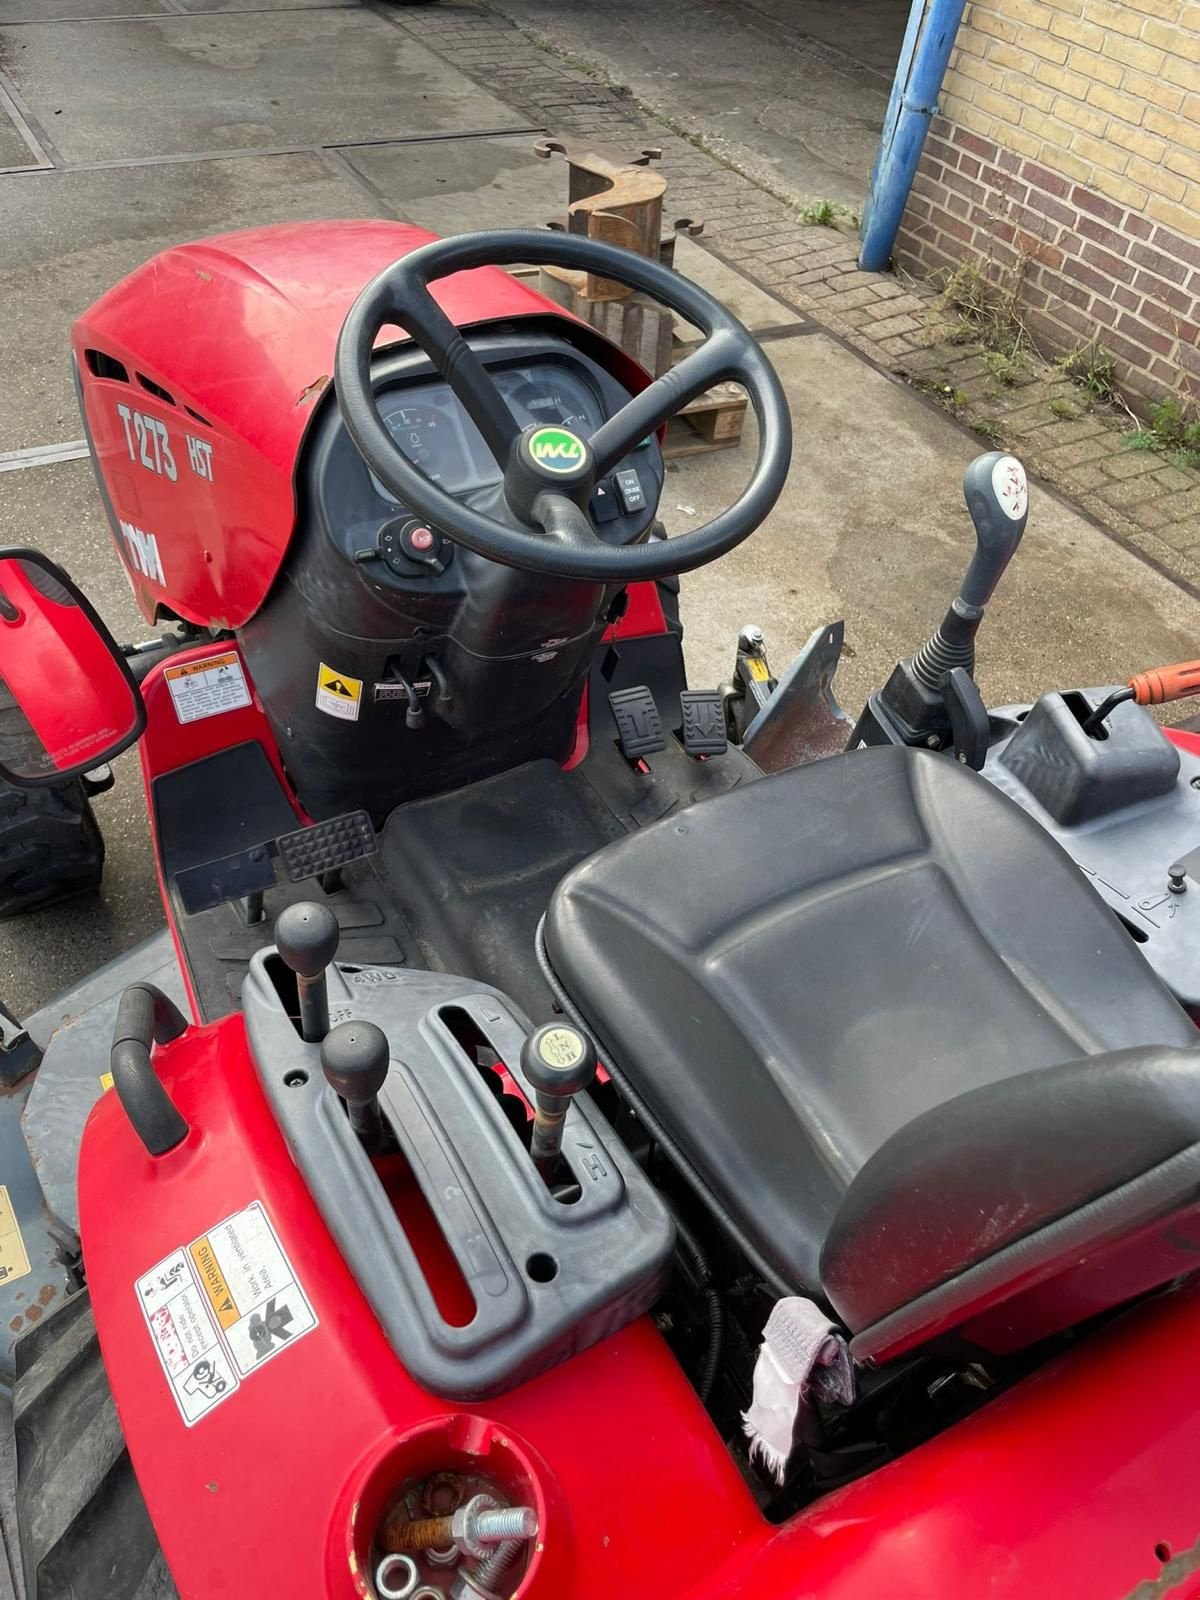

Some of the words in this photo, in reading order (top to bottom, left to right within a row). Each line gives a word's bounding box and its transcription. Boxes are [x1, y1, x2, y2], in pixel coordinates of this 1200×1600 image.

[185, 432, 214, 483] HST
[628, 494, 641, 503] OFF
[192, 658, 225, 672] WARNING
[353, 971, 397, 984] 4WD
[566, 1051, 577, 1061] H
[580, 1153, 608, 1181] H
[224, 1223, 248, 1262] ventilated
[198, 1246, 224, 1297] WARNING
[243, 1262, 252, 1273] in
[248, 1273, 262, 1298] Work
[178, 1313, 188, 1330] ride
[184, 1330, 194, 1344] not
[192, 1324, 209, 1351] except
[191, 1344, 200, 1359] Do
